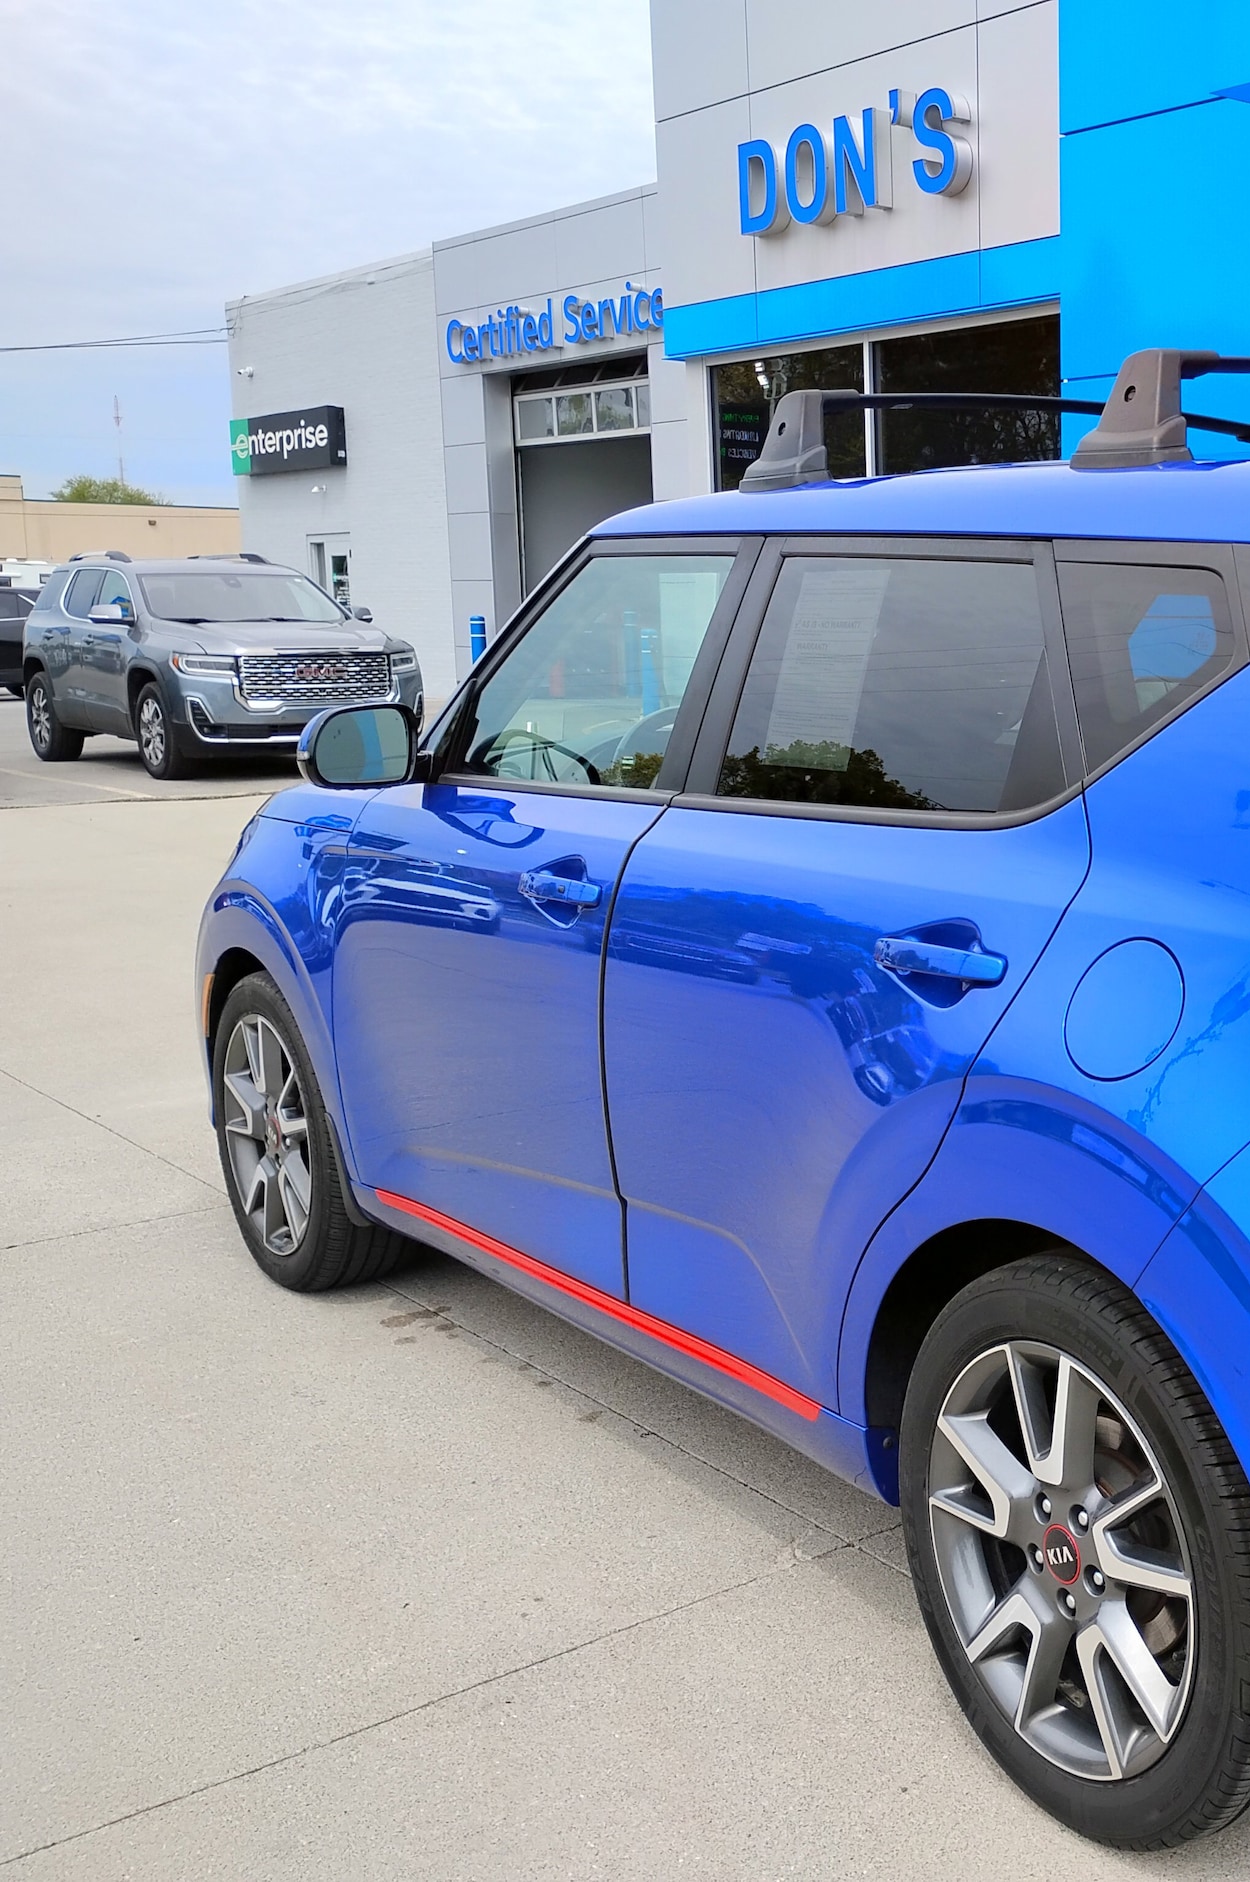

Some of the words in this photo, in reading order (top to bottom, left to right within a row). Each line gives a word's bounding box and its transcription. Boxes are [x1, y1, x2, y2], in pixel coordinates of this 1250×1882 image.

[737, 87, 960, 236] DON'S
[446, 298, 555, 364] Certified
[563, 281, 664, 344] Service
[231, 419, 329, 460] enterprise
[294, 666, 347, 678] GMC
[1046, 1545, 1074, 1566] KIA
